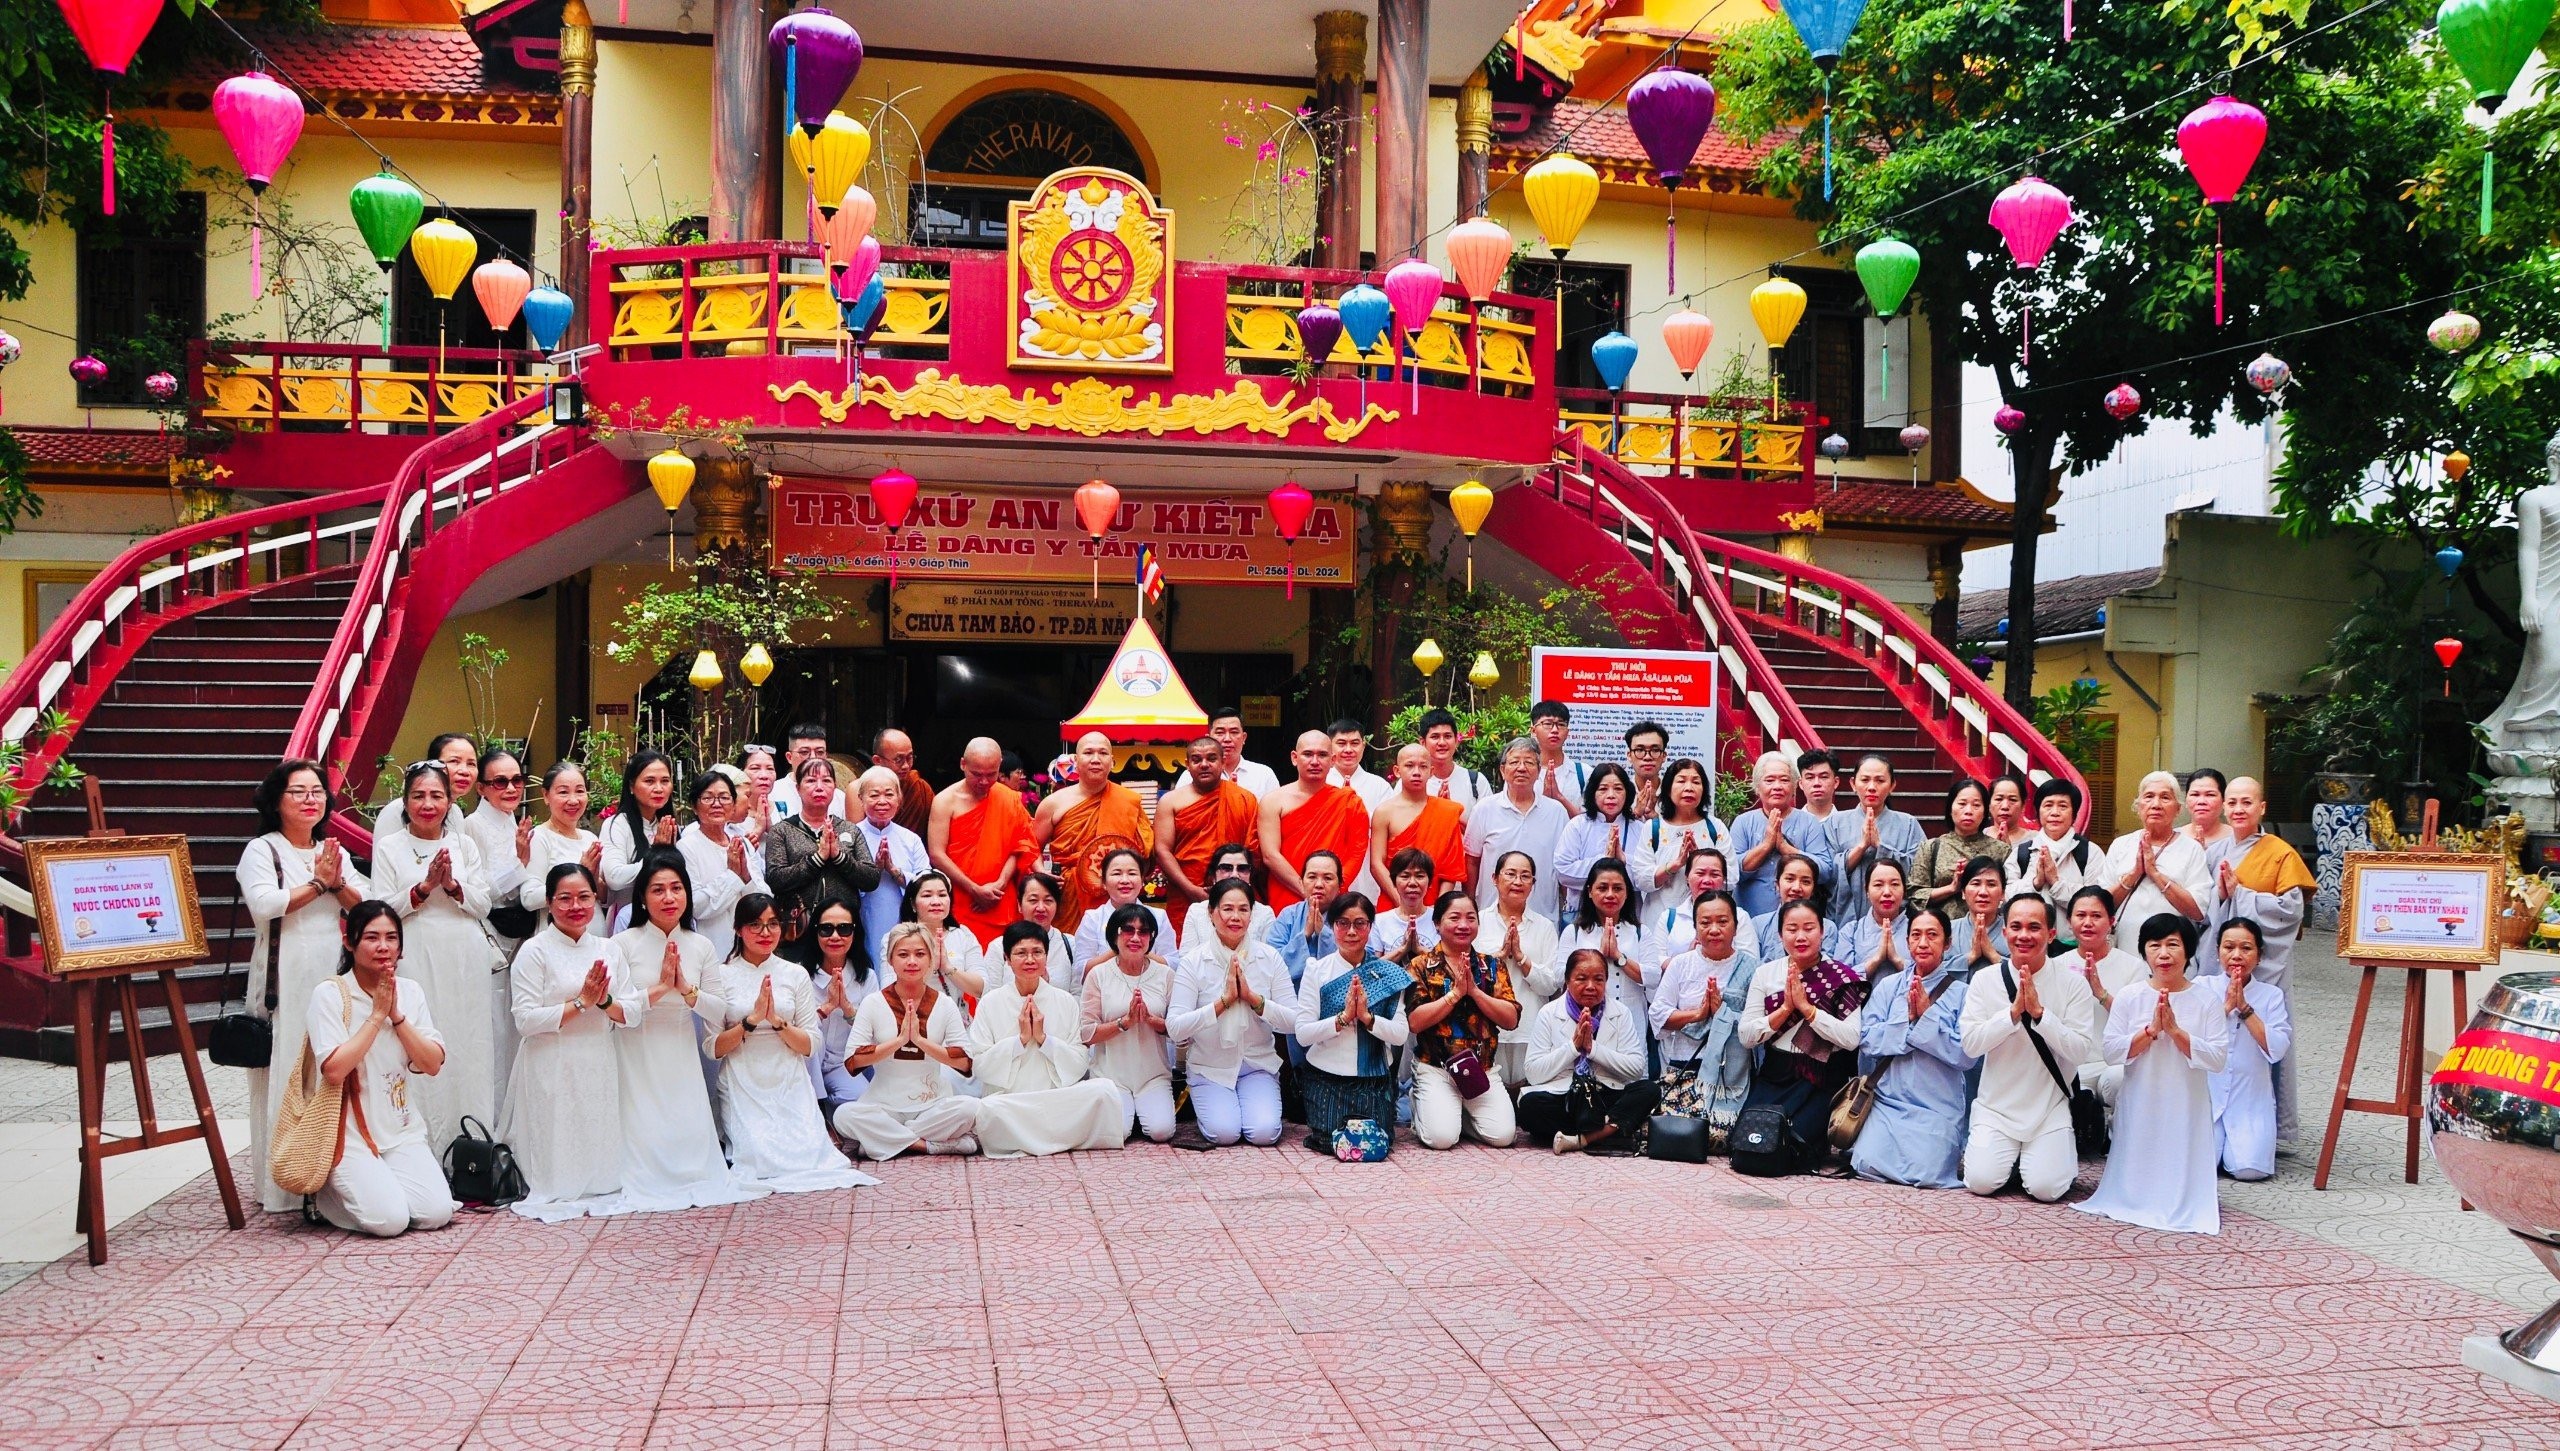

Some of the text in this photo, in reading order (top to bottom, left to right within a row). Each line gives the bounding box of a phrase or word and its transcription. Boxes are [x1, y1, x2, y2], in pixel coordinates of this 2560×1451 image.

[965, 121, 1093, 173] THERAVAD
[986, 498, 1060, 532] AN
[1152, 495, 1263, 537] KIẾT
[1275, 507, 1341, 544] Ạ
[884, 530, 927, 553] LỄ
[937, 534, 1036, 556] DÂNG
[1045, 539, 1069, 556] Y
[1167, 543, 1250, 560] MƯA
[802, 556, 829, 567] ngày
[832, 556, 846, 566] 13
[854, 557, 861, 566] 6
[863, 555, 884, 567] đến
[909, 558, 915, 567] 9
[919, 558, 945, 570] Giáp
[948, 558, 969, 569] Thìn
[1248, 566, 1262, 575] PL.
[1264, 566, 1289, 576] 2568
[1298, 567, 1312, 576] DL.
[1315, 567, 1340, 577] 2024
[990, 598, 1013, 606] NAM
[905, 609, 954, 632] CHÙA
[959, 614, 996, 633] TAM
[1000, 610, 1035, 634] BẢO
[1049, 613, 1097, 635] TP.ĐÀ
[1610, 662, 1628, 671] THƯ
[1598, 672, 1603, 680] Y
[2428, 906, 2440, 914] TAY
[2461, 1039, 2540, 1084] DƯỜNG
